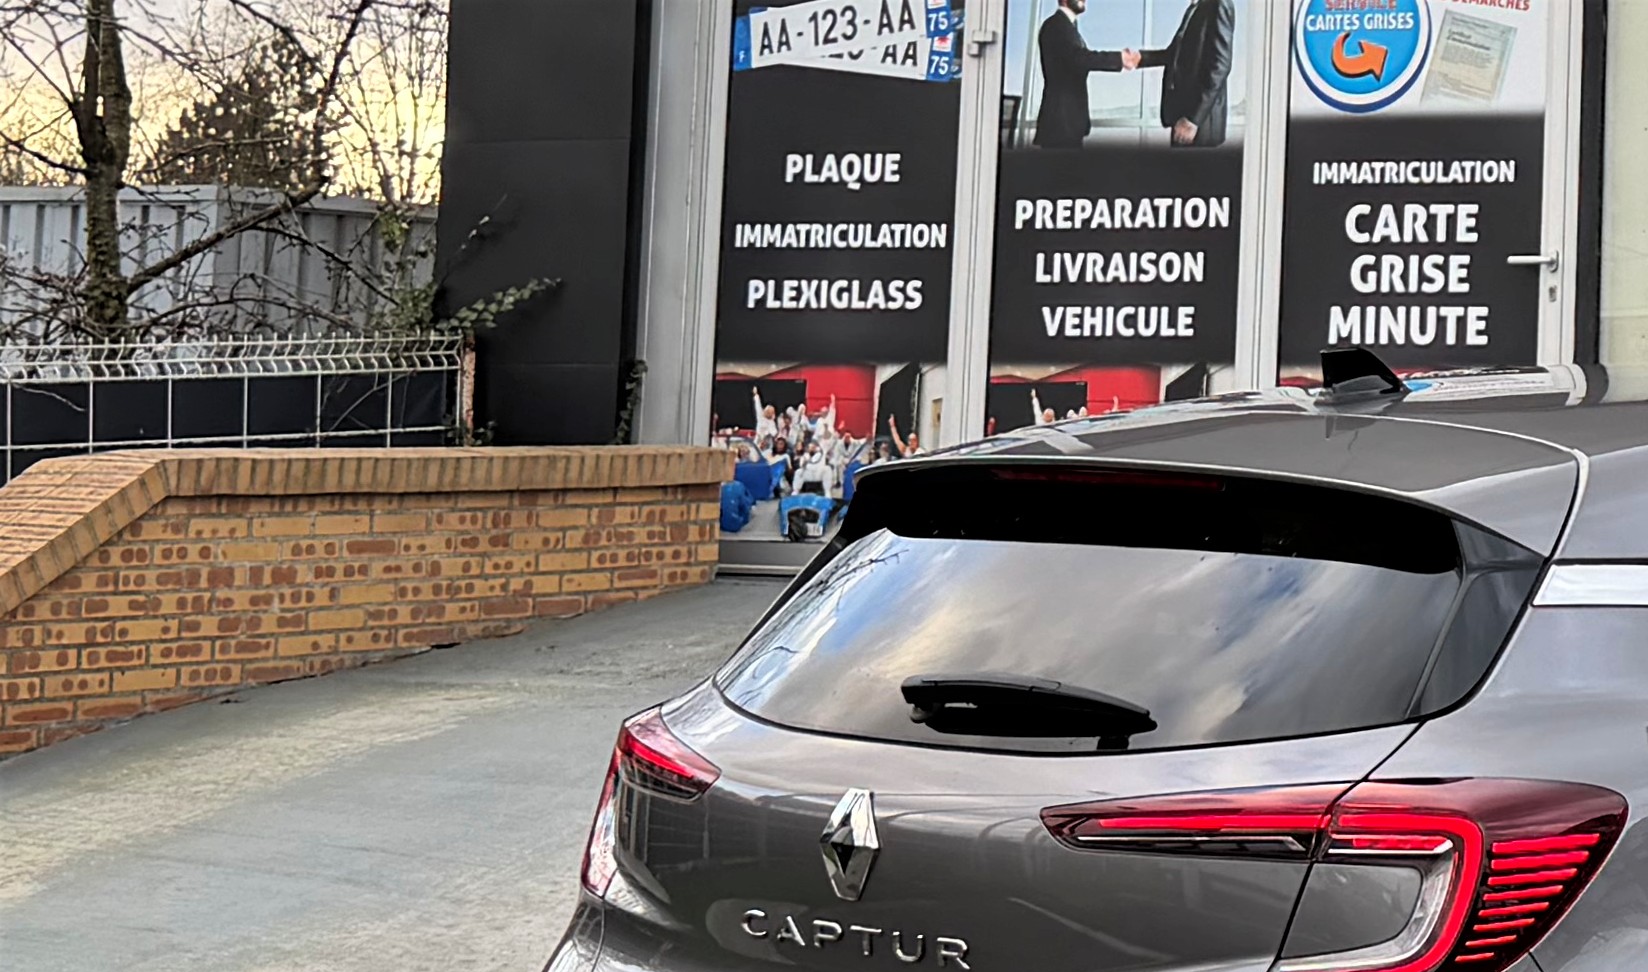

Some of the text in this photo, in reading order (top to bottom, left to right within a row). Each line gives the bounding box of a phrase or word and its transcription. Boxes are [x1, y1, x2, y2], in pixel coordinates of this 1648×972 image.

[928, 11, 949, 31] 75
[1306, 12, 1415, 31] CARTES GRISES
[930, 55, 950, 75] 75
[785, 153, 901, 190] PLAQUE
[1313, 160, 1516, 185] IMMATRICULATION
[1014, 197, 1231, 230] PREPARATION
[1344, 203, 1479, 244] CARTE
[734, 223, 948, 250] IMMATRICULATION
[1035, 252, 1205, 284] LIVRAISON
[1349, 254, 1471, 294] GRISE
[746, 279, 923, 311] PLEXIGLASS
[1042, 305, 1195, 338] VEHICULE
[1327, 306, 1489, 346] MINUTE
[741, 909, 971, 970] CAPTUR
